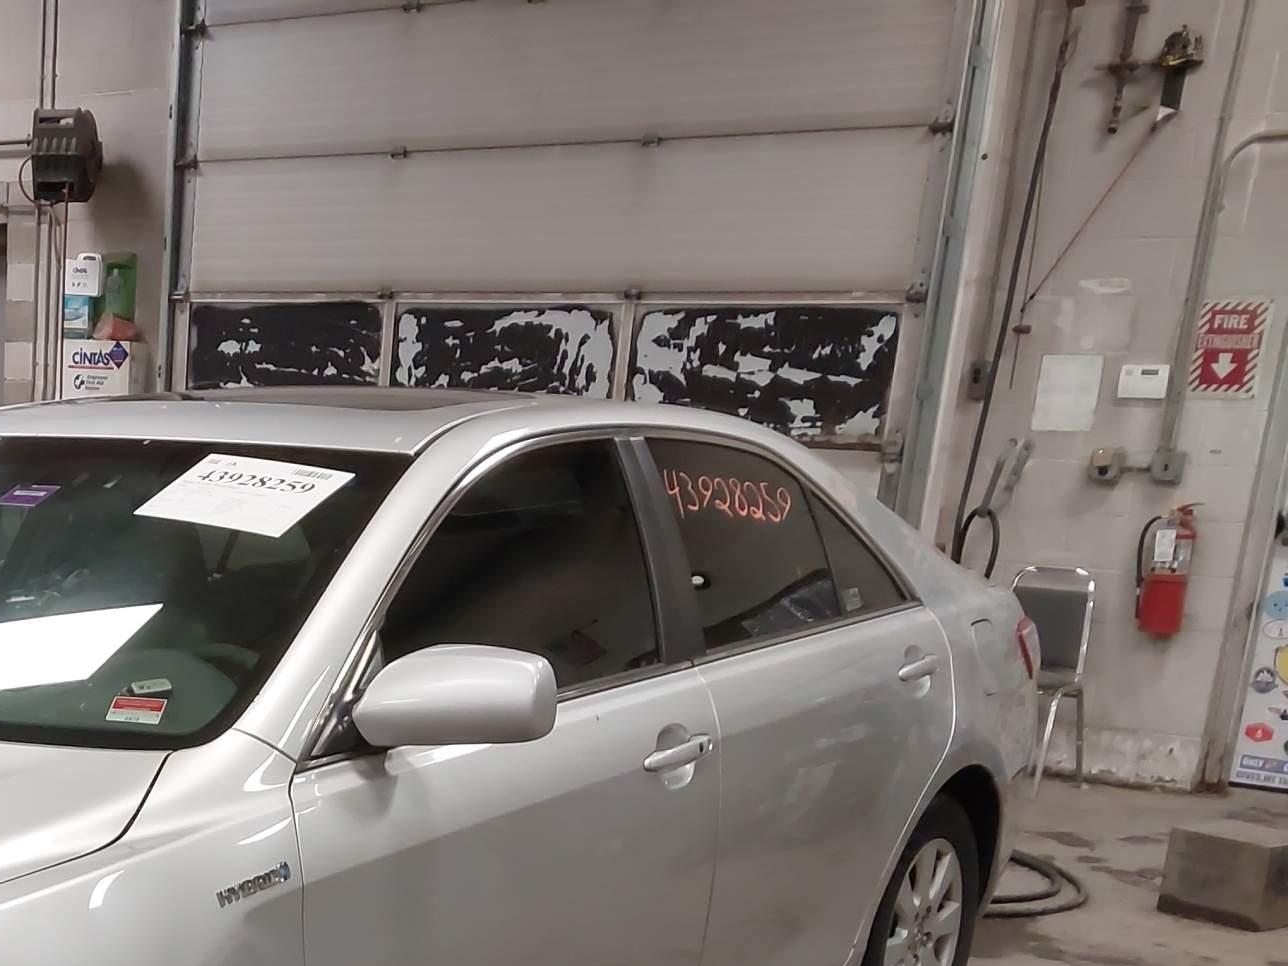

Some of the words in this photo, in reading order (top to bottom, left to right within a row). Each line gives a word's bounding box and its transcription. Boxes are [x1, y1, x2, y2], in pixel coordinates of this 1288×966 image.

[1213, 314, 1251, 329] FIRE
[197, 470, 316, 493] 43928259
[664, 468, 791, 522] 43928259
